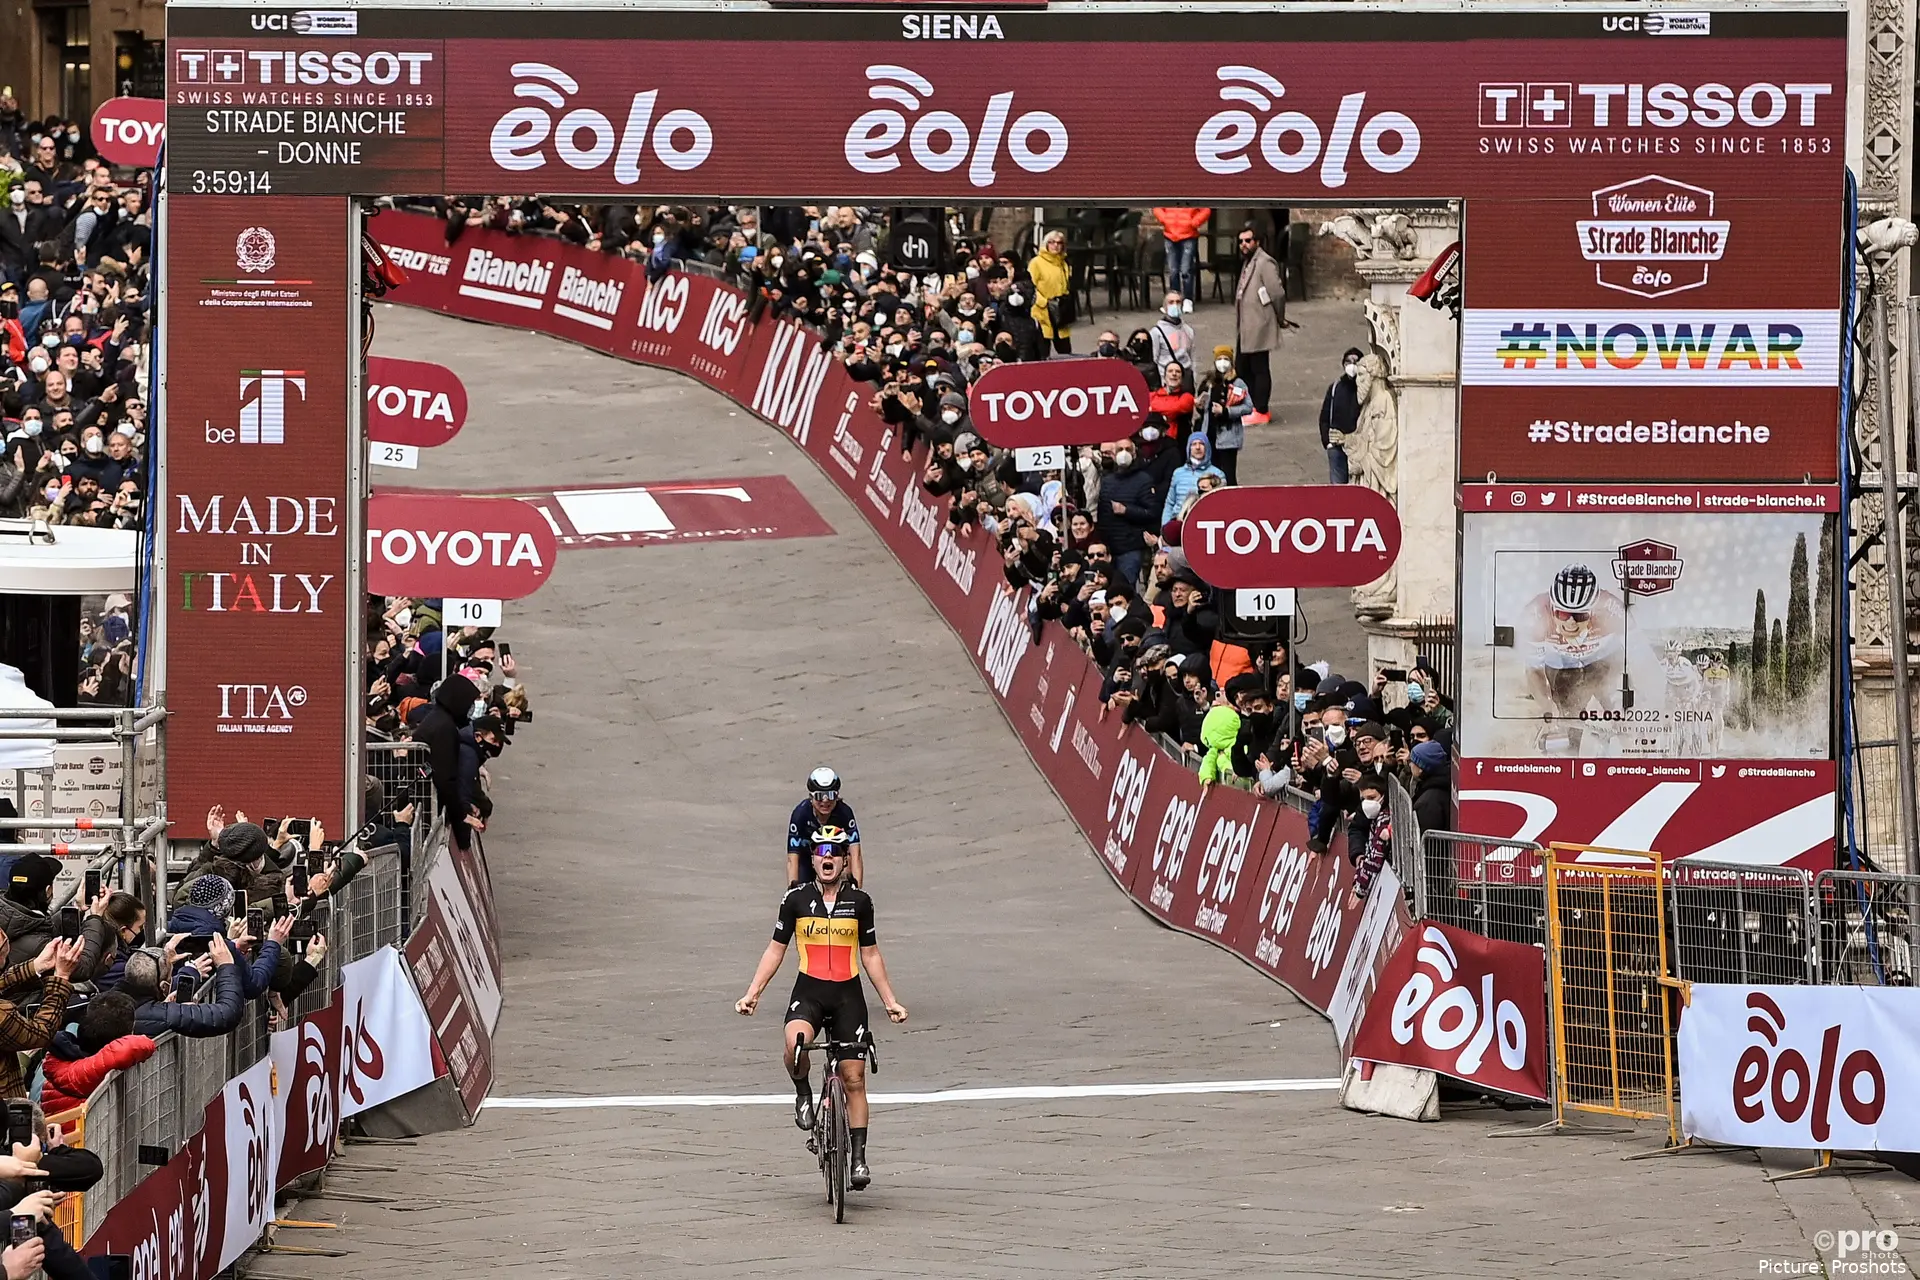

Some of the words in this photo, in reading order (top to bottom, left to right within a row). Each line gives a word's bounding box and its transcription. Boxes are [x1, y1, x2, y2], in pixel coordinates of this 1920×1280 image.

[251, 14, 288, 30] UCI
[902, 14, 1004, 39] SIENA
[1602, 16, 1640, 31] UCI
[248, 51, 432, 85] TISSOT
[177, 91, 232, 104] SWISS
[243, 92, 324, 105] WATCHES
[334, 92, 386, 105] SINCE
[396, 93, 433, 106] 1853
[1578, 82, 1832, 127] TISSOT
[100, 118, 166, 146] TOY
[206, 110, 295, 134] STRADE
[303, 111, 406, 135] BIANCHE
[489, 89, 714, 185] eolo
[844, 91, 1069, 187] eolo
[1195, 91, 1421, 188] eolo
[1479, 137, 1556, 154] SWISS
[1569, 137, 1681, 154] WATCHES
[1695, 137, 1766, 154] SINCE
[1781, 137, 1832, 154] 1853
[278, 141, 361, 165] DONNE
[192, 170, 272, 194] 3:59:14
[1607, 194, 1662, 214] Women
[1665, 193, 1697, 213] Elite
[1586, 226, 1646, 254] Strade
[1650, 226, 1720, 255] Bianche
[463, 248, 555, 295] Bianchi
[1632, 268, 1672, 287] eolo
[221, 299, 265, 307] Cooperazione
[243, 290, 259, 299] degli
[558, 265, 624, 316] Bianchi
[632, 339, 672, 357] eyewear
[1496, 323, 1804, 370] #NOWAR
[690, 354, 727, 380] eyewear
[981, 385, 1139, 423] TOYOTA
[205, 420, 236, 444] be
[1528, 419, 1770, 445] #StradeBianche
[384, 447, 404, 462] 25
[1032, 450, 1053, 467] 25
[1576, 491, 1692, 507] #StradeBianche
[1704, 493, 1826, 508] strade-bianche.it
[175, 494, 338, 536] MADE
[1197, 518, 1387, 554] TOYOTA
[240, 543, 273, 565] IN
[179, 572, 334, 613] ITALY
[1253, 593, 1276, 611] 10
[460, 603, 482, 620] 10
[217, 685, 293, 719] ITA
[1580, 710, 1660, 722] 05.03.2022
[1674, 710, 1713, 722] SIENA
[217, 725, 242, 733] ITALIAN
[244, 725, 265, 733] TRADE
[266, 725, 293, 733] AGENCY
[1494, 764, 1561, 774] stradebianche
[1607, 765, 1691, 776] @strade_bianche
[1738, 767, 1816, 779] @StradeBianche
[1107, 748, 1156, 848] enel
[1152, 788, 1206, 884] enel
[1196, 803, 1260, 905] enel
[815, 926, 828, 935] sd
[830, 928, 855, 937] worx
[1305, 888, 1344, 980] eolo
[1390, 972, 1527, 1075] eolo
[1732, 1024, 1887, 1142] eolo
